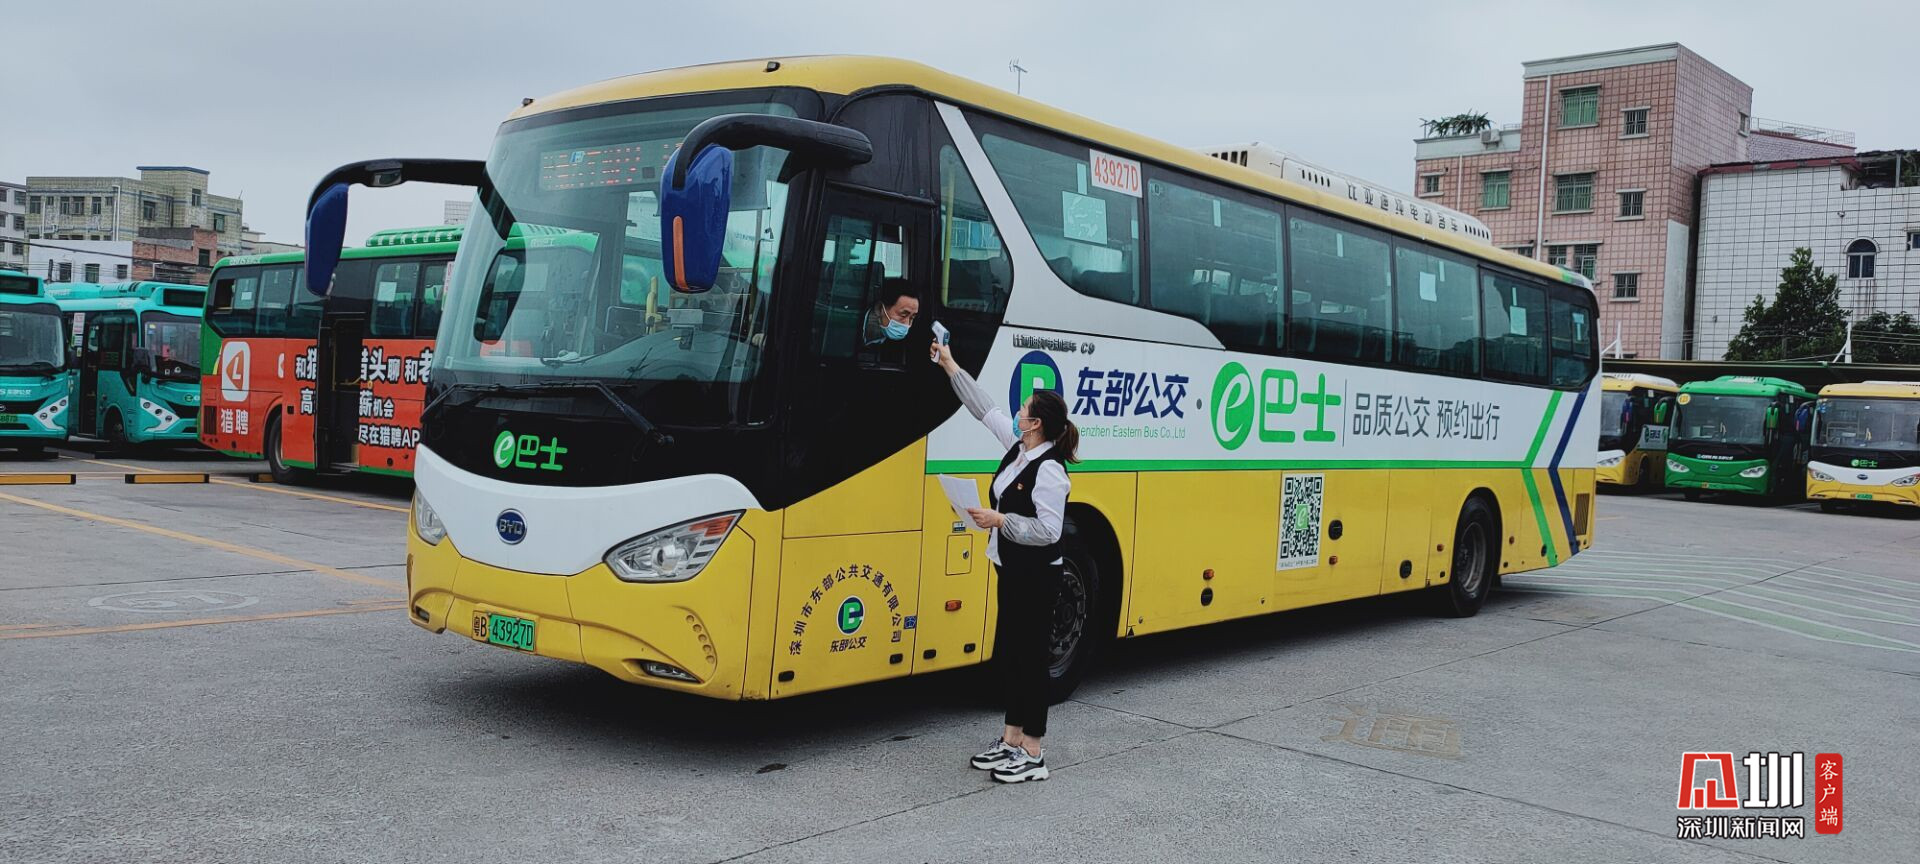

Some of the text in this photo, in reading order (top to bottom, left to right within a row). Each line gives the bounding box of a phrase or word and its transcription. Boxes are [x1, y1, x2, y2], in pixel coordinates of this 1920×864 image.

[1094, 156, 1139, 192] 43927D
[1071, 366, 1190, 419] 东部公交
[220, 408, 249, 435] 猎聘
[1077, 424, 1112, 438] enzhen
[1112, 424, 1142, 438] Eastern
[1143, 425, 1159, 438] Bus
[1352, 392, 1501, 441] 品质公交 预约出行
[499, 518, 523, 535] BYD
[788, 563, 903, 657] 深圳市东部公共交通有限公司
[829, 636, 868, 654] 东部公交
